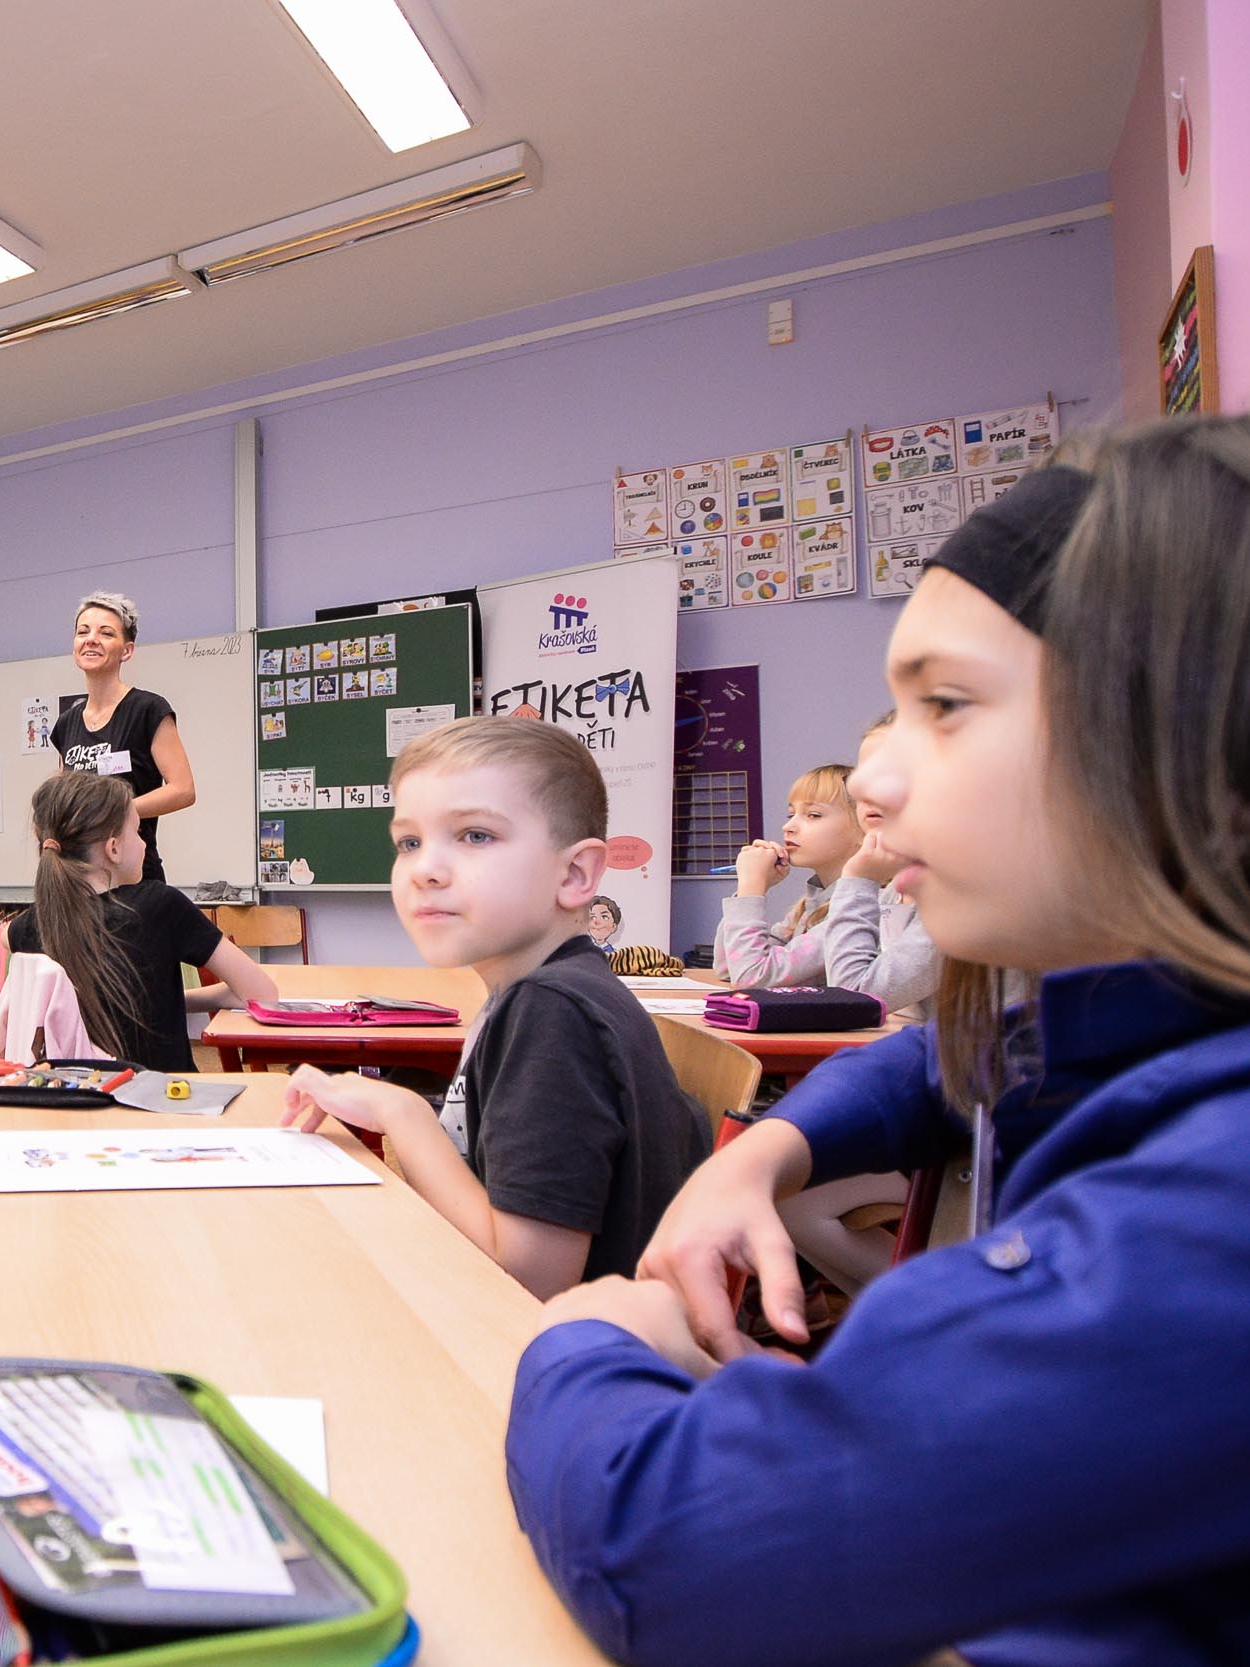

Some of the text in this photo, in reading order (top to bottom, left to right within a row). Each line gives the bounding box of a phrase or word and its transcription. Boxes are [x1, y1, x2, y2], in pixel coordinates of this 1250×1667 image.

[989, 427, 1026, 443] PAPÍR
[890, 447, 926, 460] LÁTKA
[803, 458, 839, 470] ČTVEREC
[687, 481, 708, 491] KRUH
[903, 503, 924, 514] KOV
[808, 542, 839, 553] KVÁDR
[747, 551, 773, 562] KOULE
[538, 624, 598, 650] Krašovská
[65, 742, 111, 766] ETIKETA
[350, 791, 365, 804] kg
[382, 792, 390, 804] g
